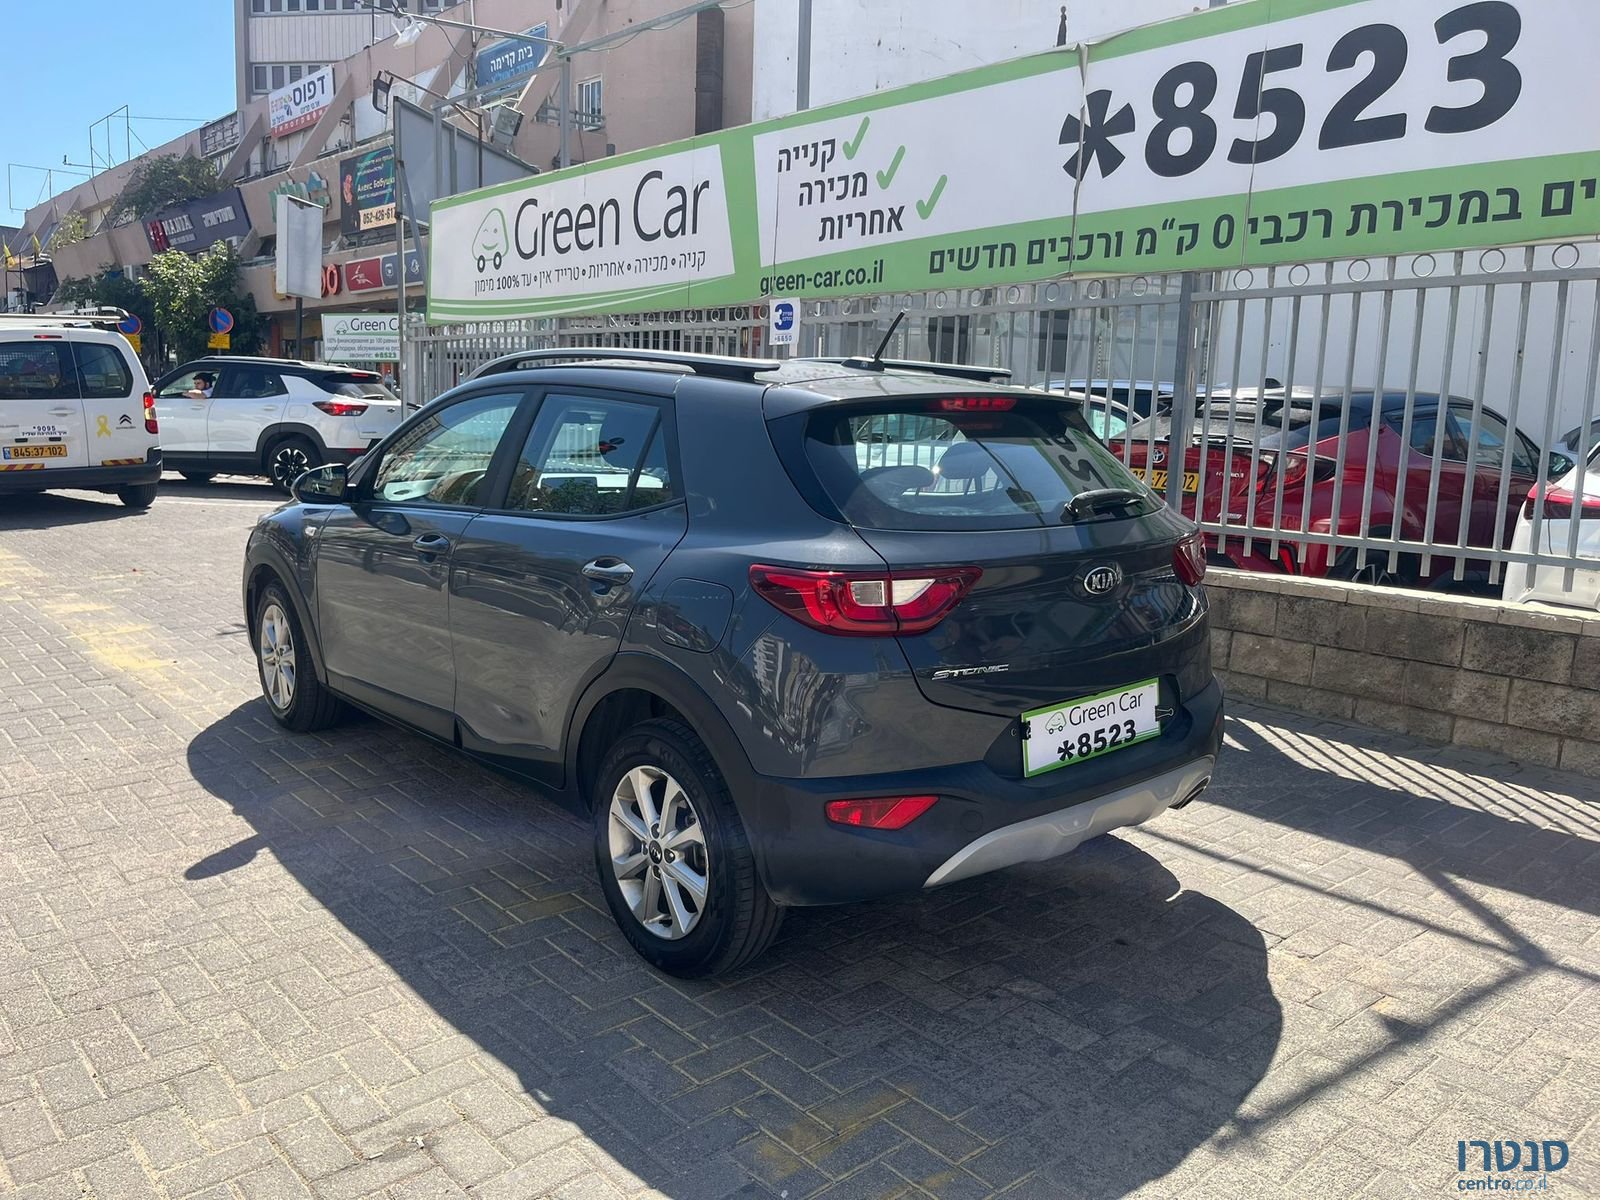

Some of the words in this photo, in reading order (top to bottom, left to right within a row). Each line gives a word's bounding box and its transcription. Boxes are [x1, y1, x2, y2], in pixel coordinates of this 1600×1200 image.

[490, 51, 515, 72] קדימה
[518, 46, 533, 61] בית
[293, 75, 326, 106] דפוס
[778, 138, 836, 172] קנייה
[798, 172, 868, 206] מכירה
[514, 198, 620, 260] Green
[633, 170, 710, 242] Car
[1346, 188, 1522, 236] במכירת
[818, 206, 905, 242] אחריות
[1212, 214, 1235, 250] 0
[1248, 208, 1333, 246] רכבי
[929, 242, 1016, 274] חדשים
[1026, 231, 1124, 265] ורכבים
[588, 260, 624, 280] אחריות
[634, 260, 668, 274] מכירה
[678, 250, 706, 272] קניה
[496, 274, 520, 290] 100%
[520, 272, 532, 287] עד
[539, 270, 552, 288] אין
[554, 266, 580, 282] טרייד
[760, 259, 884, 297] green-car.co.il
[474, 277, 494, 296] מימון
[350, 318, 386, 331] Green
[388, 318, 400, 331] C
[1091, 573, 1115, 590] KIA
[932, 664, 1010, 681] STONIC
[1069, 701, 1116, 726] Green
[1118, 692, 1144, 712] Car
